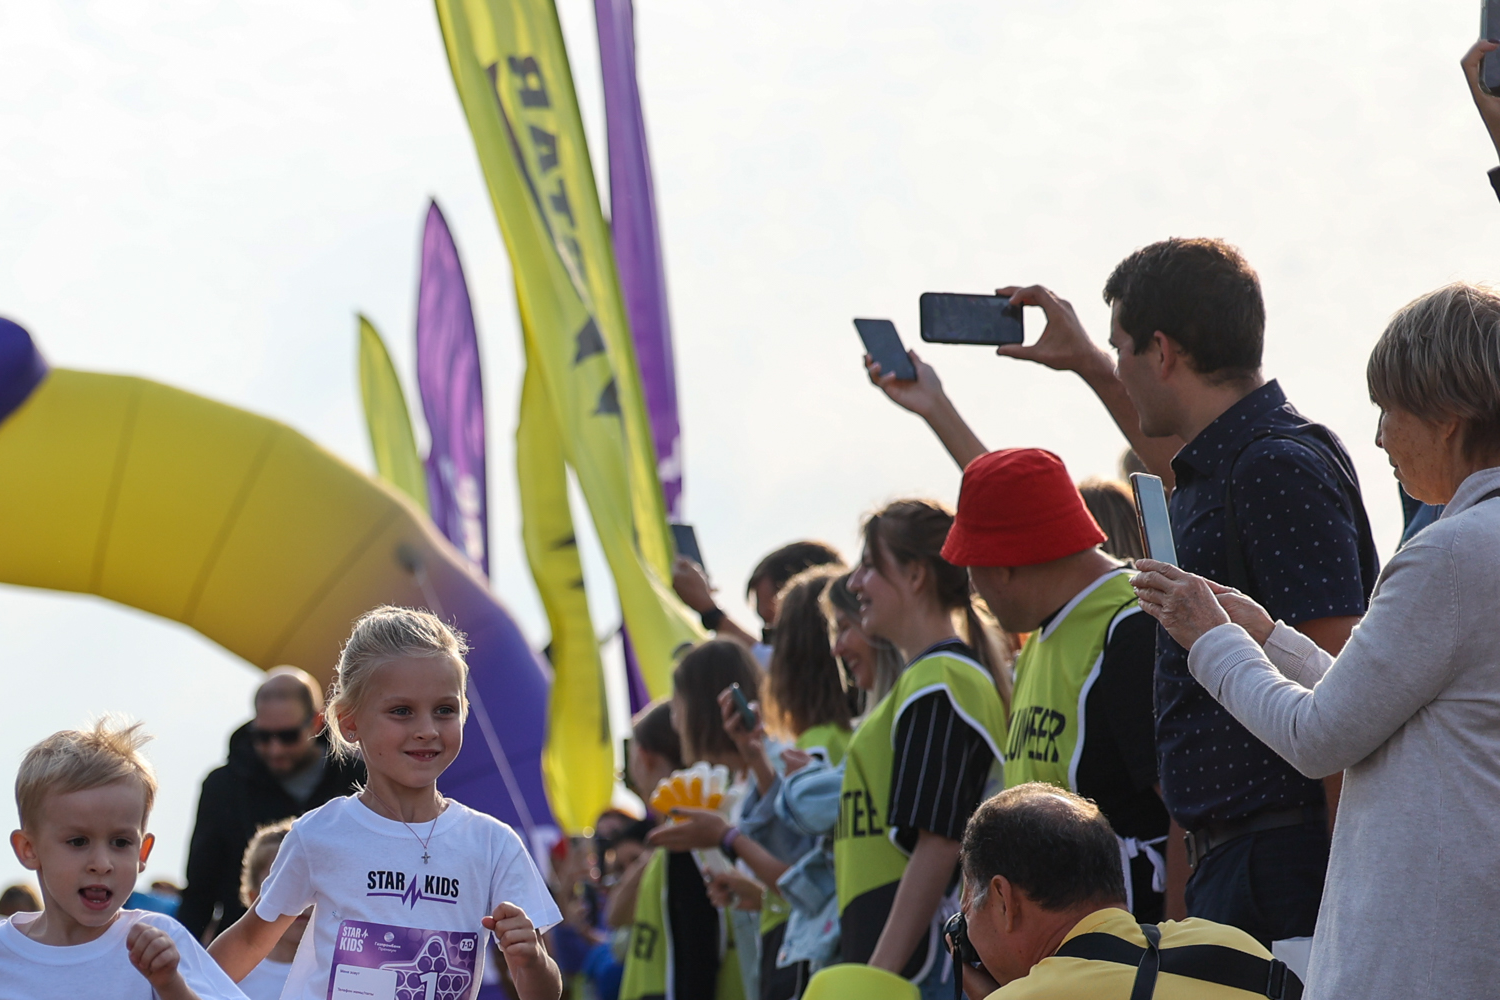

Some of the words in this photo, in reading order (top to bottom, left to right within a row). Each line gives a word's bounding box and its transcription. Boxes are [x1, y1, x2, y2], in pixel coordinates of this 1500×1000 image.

[367, 870, 405, 891] STAR
[424, 875, 460, 898] KIDS
[342, 926, 361, 938] STAR
[339, 937, 363, 952] KIDS
[462, 941, 473, 949] 7-12
